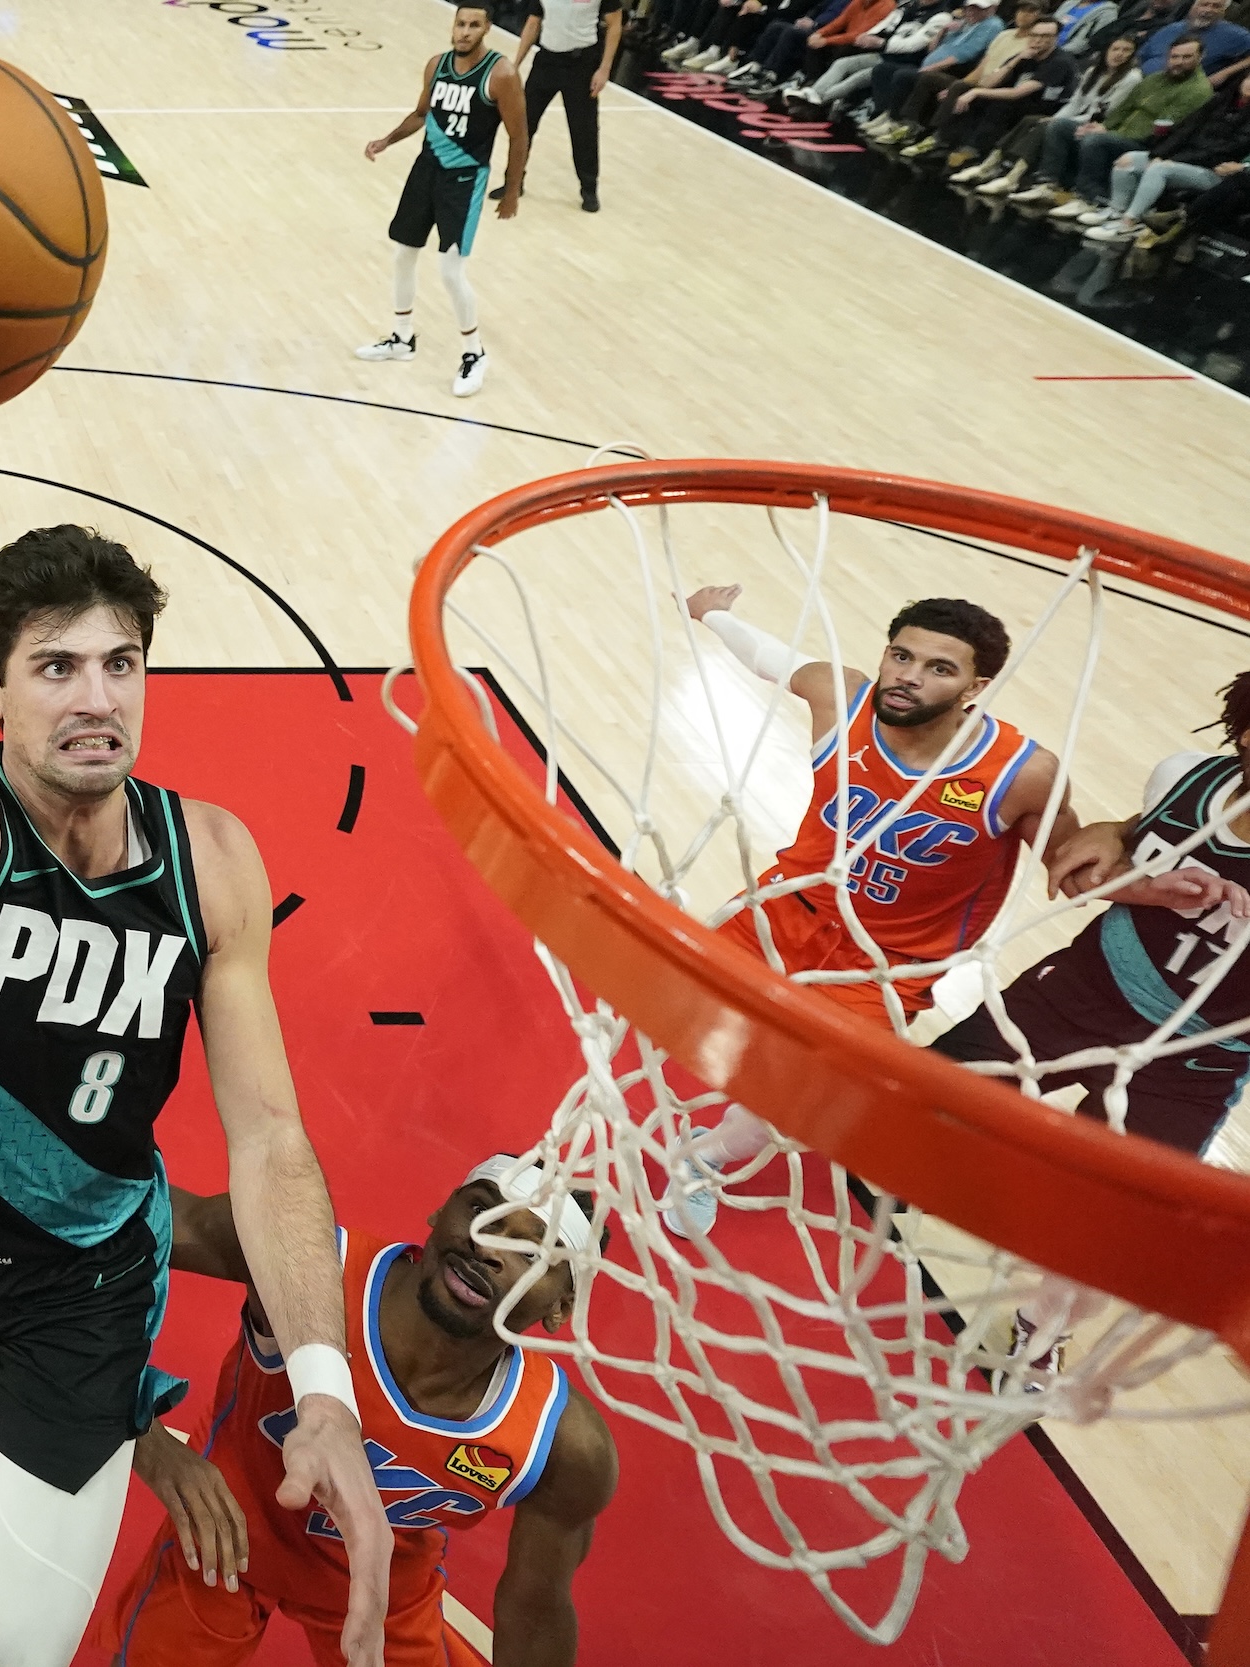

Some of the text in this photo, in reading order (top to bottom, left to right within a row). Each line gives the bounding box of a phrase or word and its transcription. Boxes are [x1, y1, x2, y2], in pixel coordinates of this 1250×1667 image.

[430, 80, 476, 114] PDX
[445, 113, 469, 138] 24
[820, 784, 980, 867] OKC
[68, 1050, 126, 1125] 8
